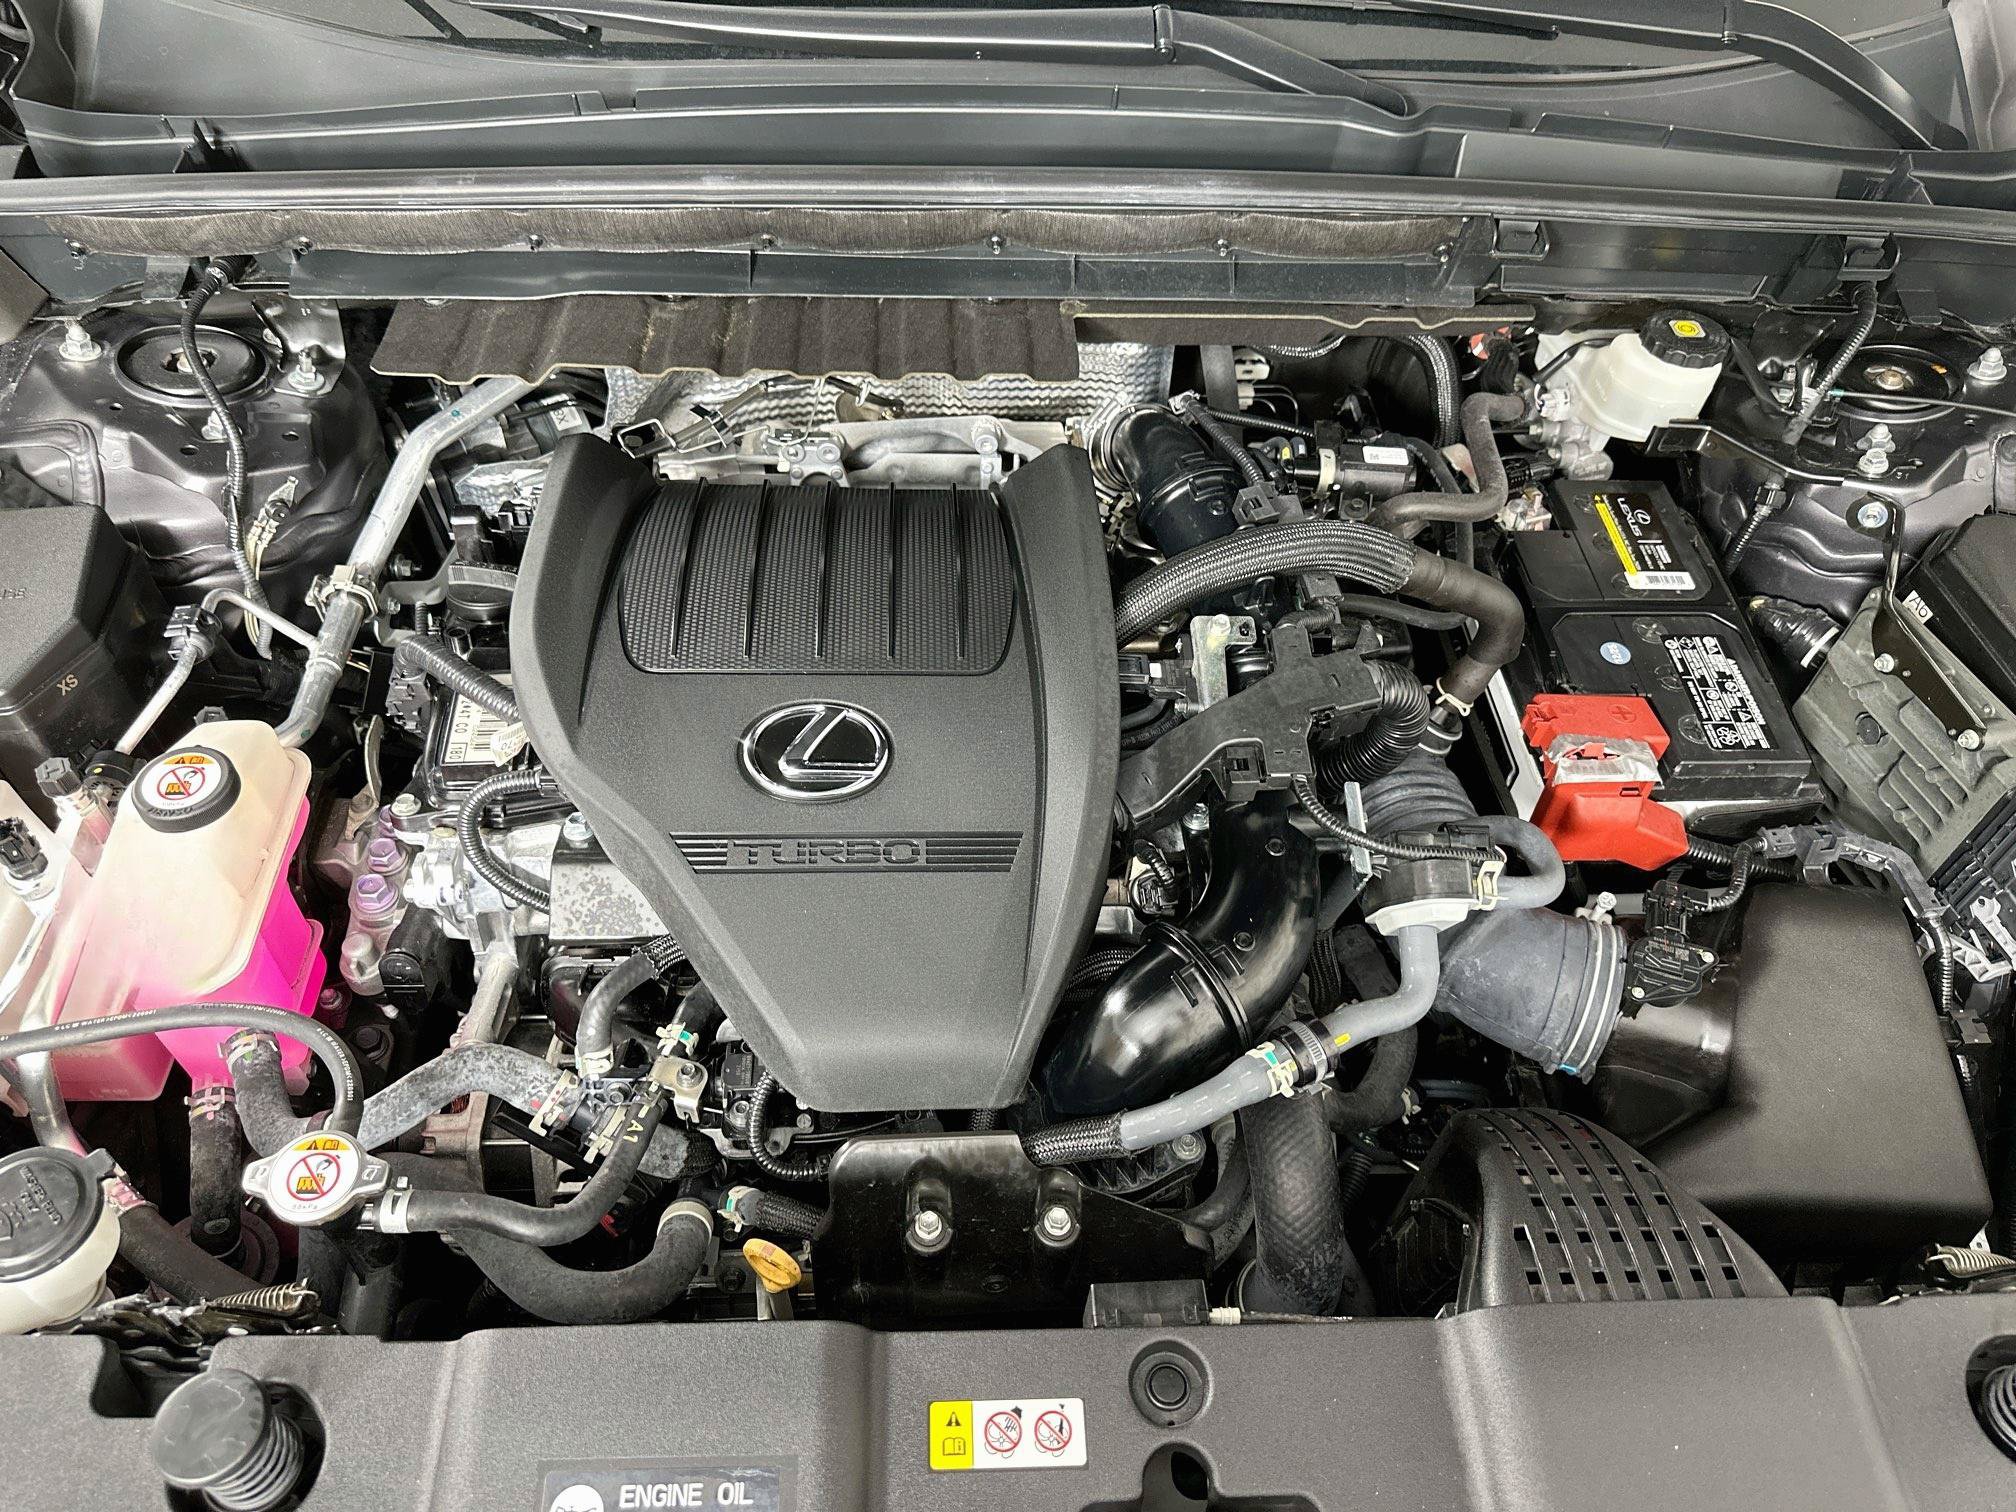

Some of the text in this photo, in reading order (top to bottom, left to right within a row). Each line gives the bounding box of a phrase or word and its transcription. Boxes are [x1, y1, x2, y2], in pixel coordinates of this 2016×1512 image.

[1617, 497, 1643, 536] LEXUS
[1908, 596, 1928, 618] A6
[732, 839, 921, 865] TURBO
[619, 1481, 754, 1509] ENGINE OIL
